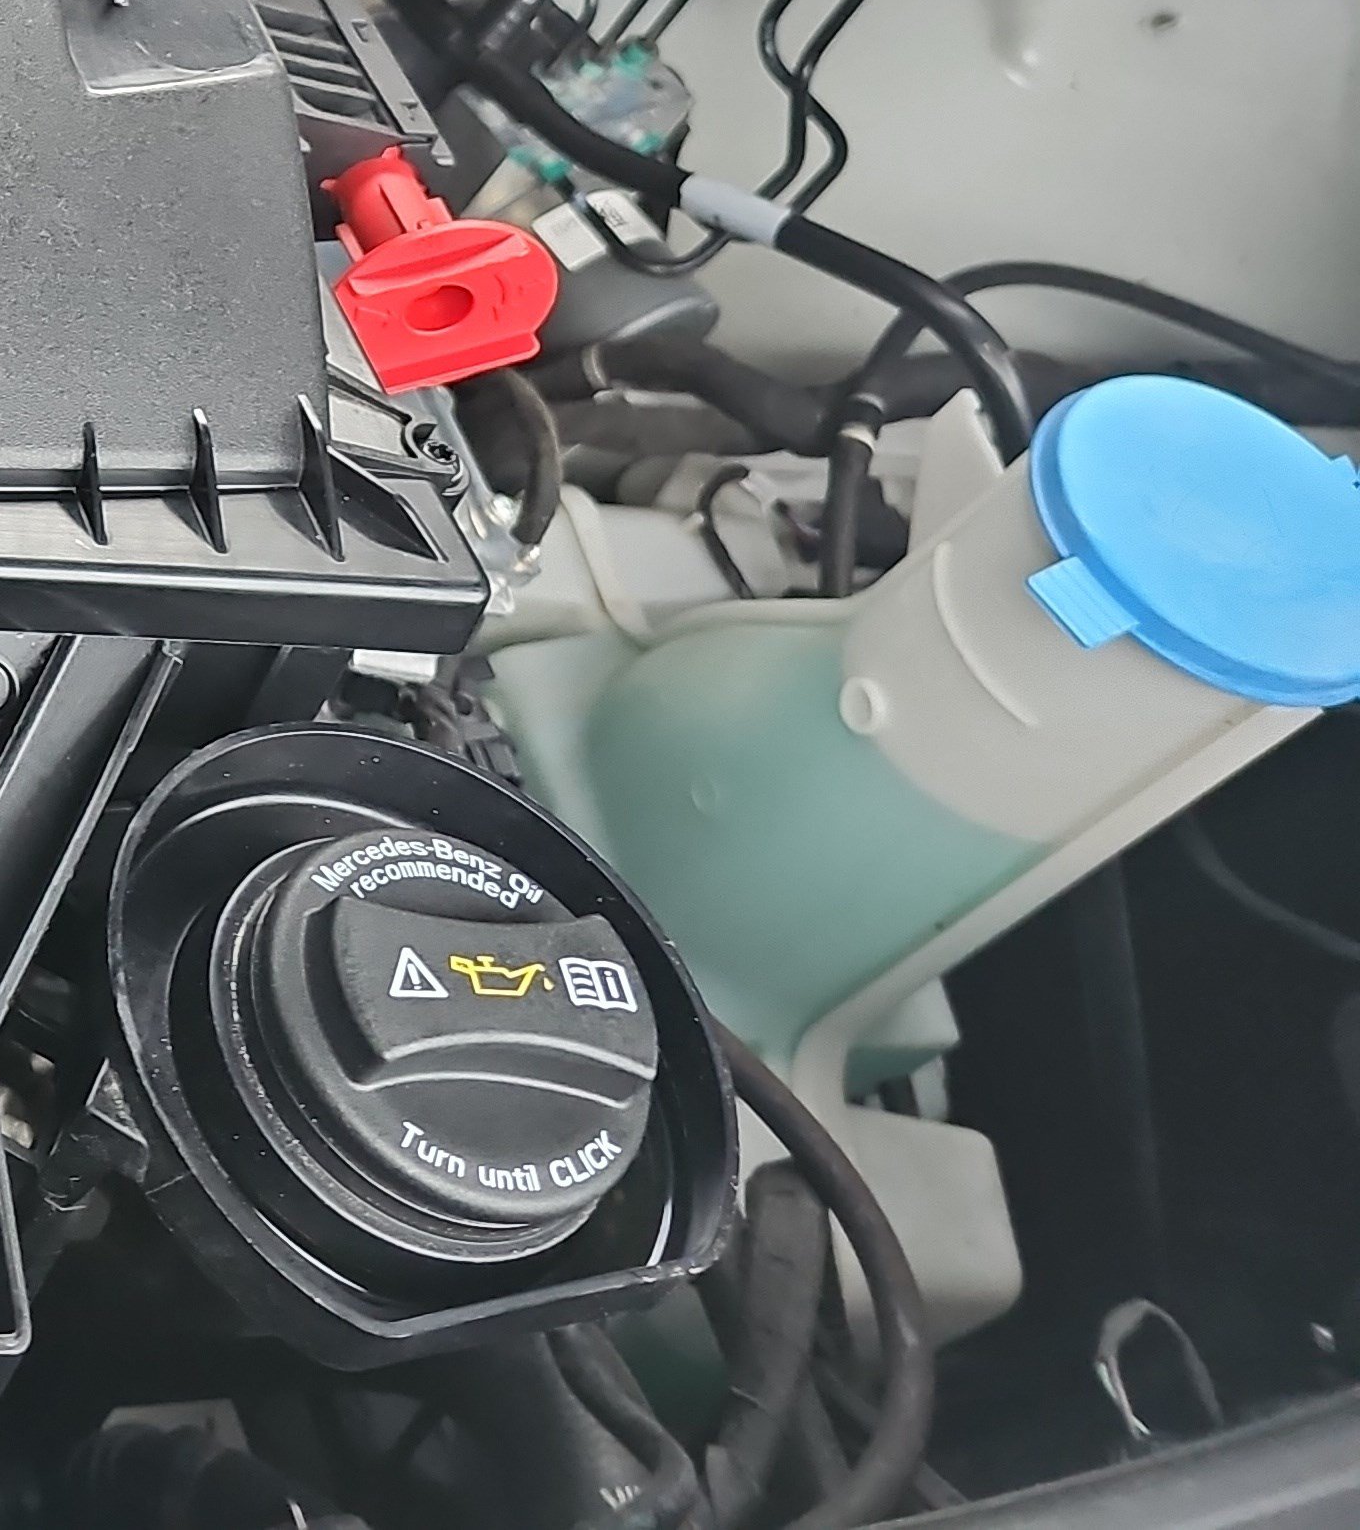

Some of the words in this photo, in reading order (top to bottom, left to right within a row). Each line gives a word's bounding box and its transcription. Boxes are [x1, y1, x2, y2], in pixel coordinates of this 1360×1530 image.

[311, 836, 502, 891] Mercedes-Benz
[509, 874, 545, 905] Oil
[350, 859, 521, 910] recommended
[402, 1121, 466, 1178] Turn
[478, 1164, 541, 1192] until
[551, 1129, 622, 1188] CLICK
